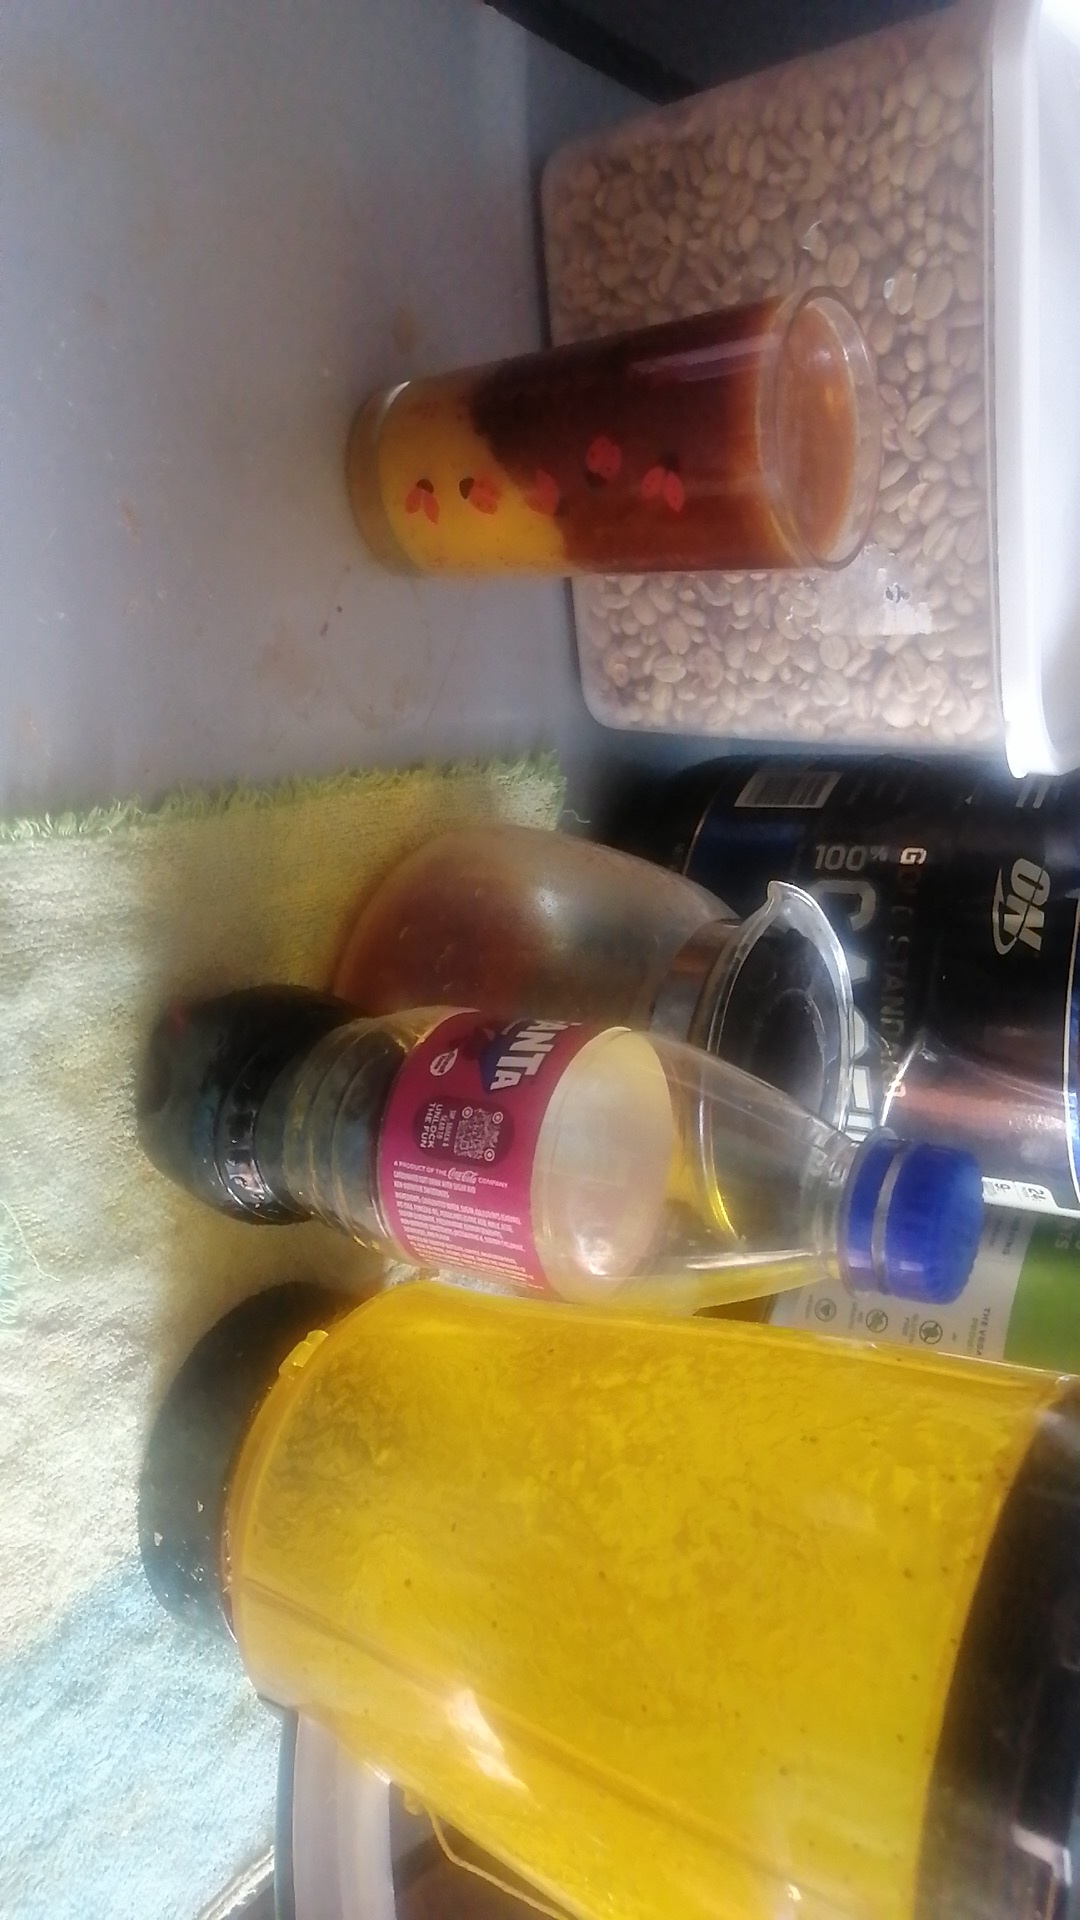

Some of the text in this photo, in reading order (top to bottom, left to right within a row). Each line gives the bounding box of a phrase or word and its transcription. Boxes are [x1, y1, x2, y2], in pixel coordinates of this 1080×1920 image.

[814, 844, 889, 871] 100%
[1003, 858, 1051, 952] ON
[490, 1018, 583, 1091] ANTA
[419, 1102, 437, 1149] THE FUN
[427, 1103, 444, 1149] UNLOCK
[399, 1161, 426, 1173] PRODUCT
[426, 1166, 435, 1174] OF
[435, 1168, 448, 1177] THE
[477, 1177, 509, 1189] COMPANY
[981, 1306, 992, 1327] THE
